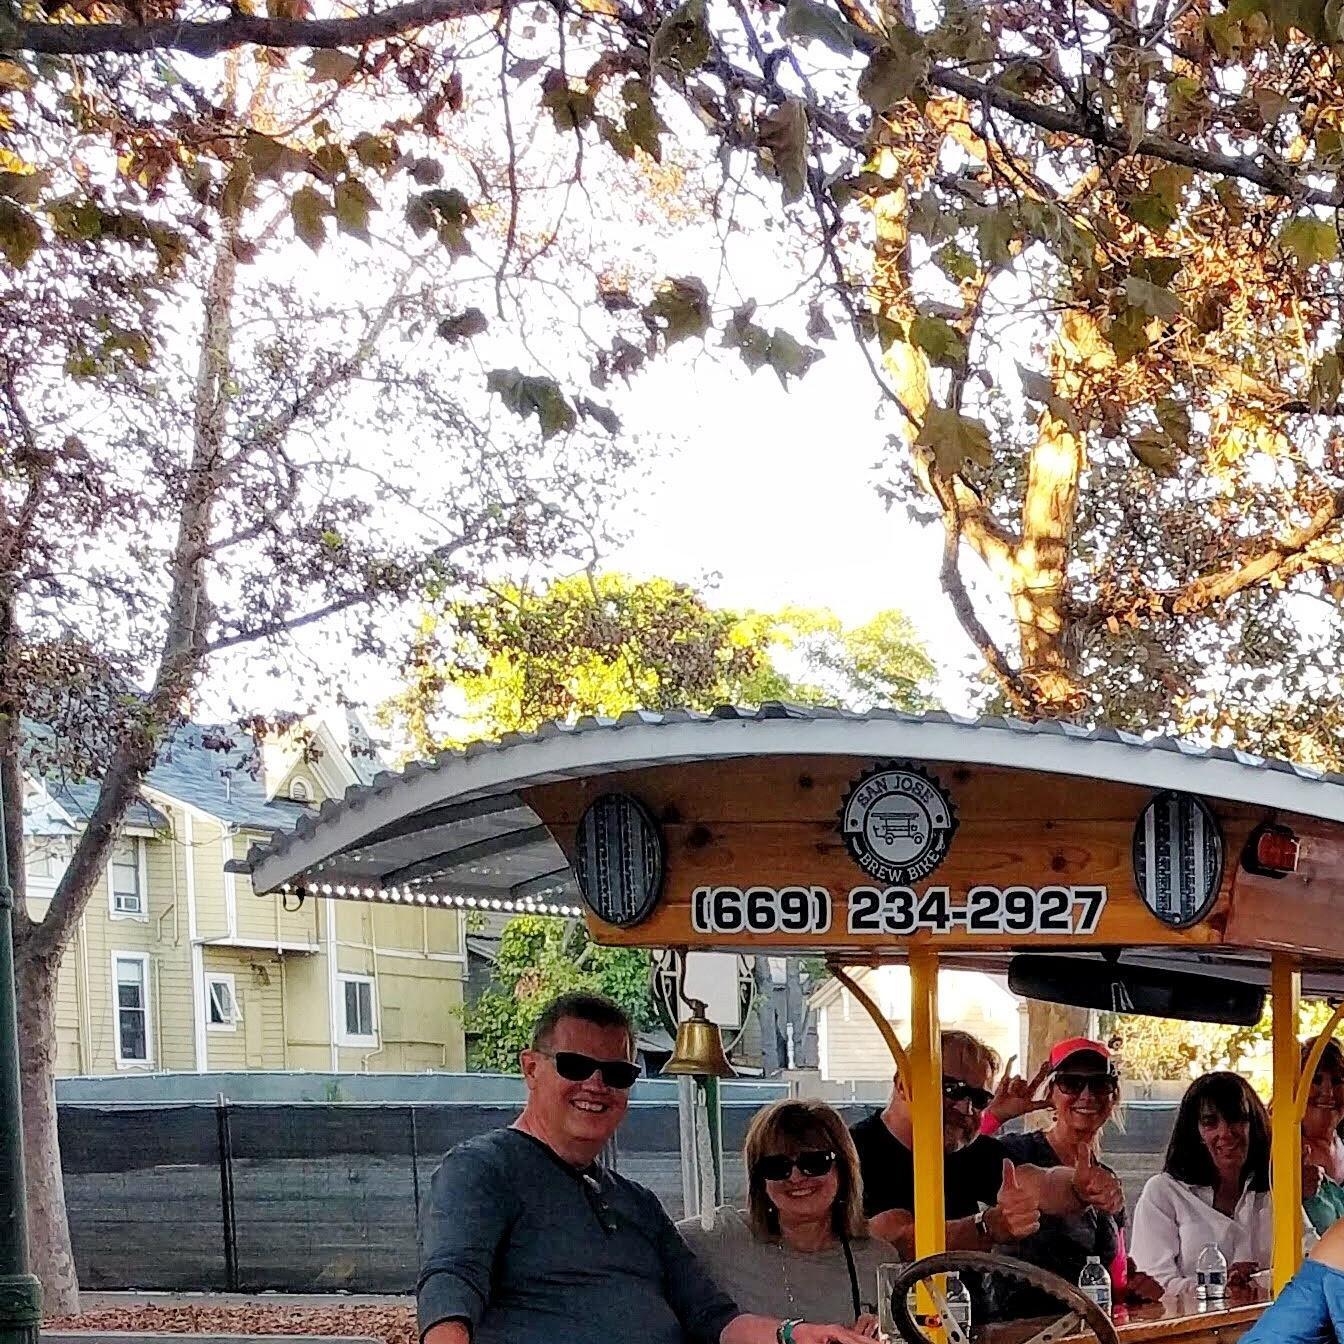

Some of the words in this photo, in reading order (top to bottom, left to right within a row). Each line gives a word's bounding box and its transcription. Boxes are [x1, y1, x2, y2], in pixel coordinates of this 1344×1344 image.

[858, 776, 888, 807] SAN
[894, 776, 934, 804] JOSE
[860, 854, 902, 882] BREW
[908, 850, 940, 881] BIKE
[692, 887, 831, 933] (669)
[847, 886, 1107, 934] 234-2927
